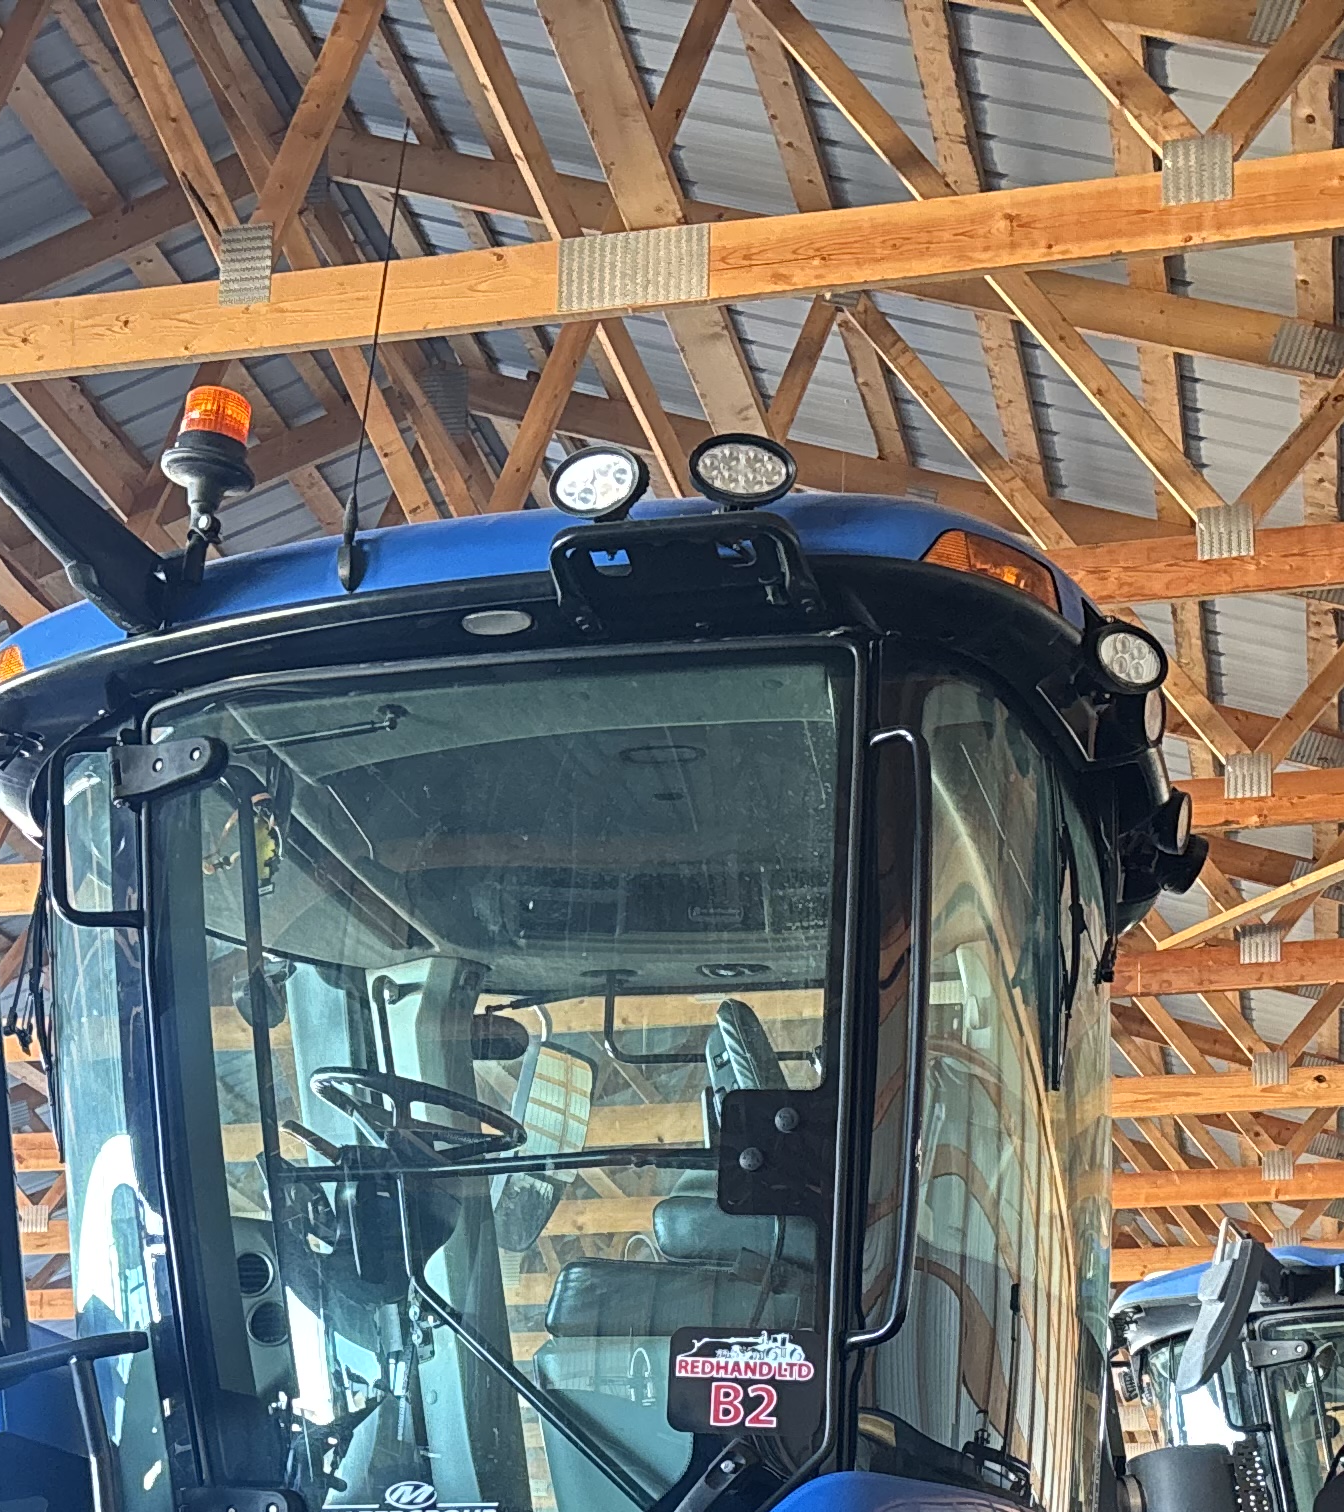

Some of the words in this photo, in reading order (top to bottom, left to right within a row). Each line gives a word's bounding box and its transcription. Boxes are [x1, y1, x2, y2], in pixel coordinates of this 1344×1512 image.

[676, 1358, 773, 1379] REDHAND
[775, 1361, 814, 1381] LTD
[710, 1382, 777, 1428] B2
